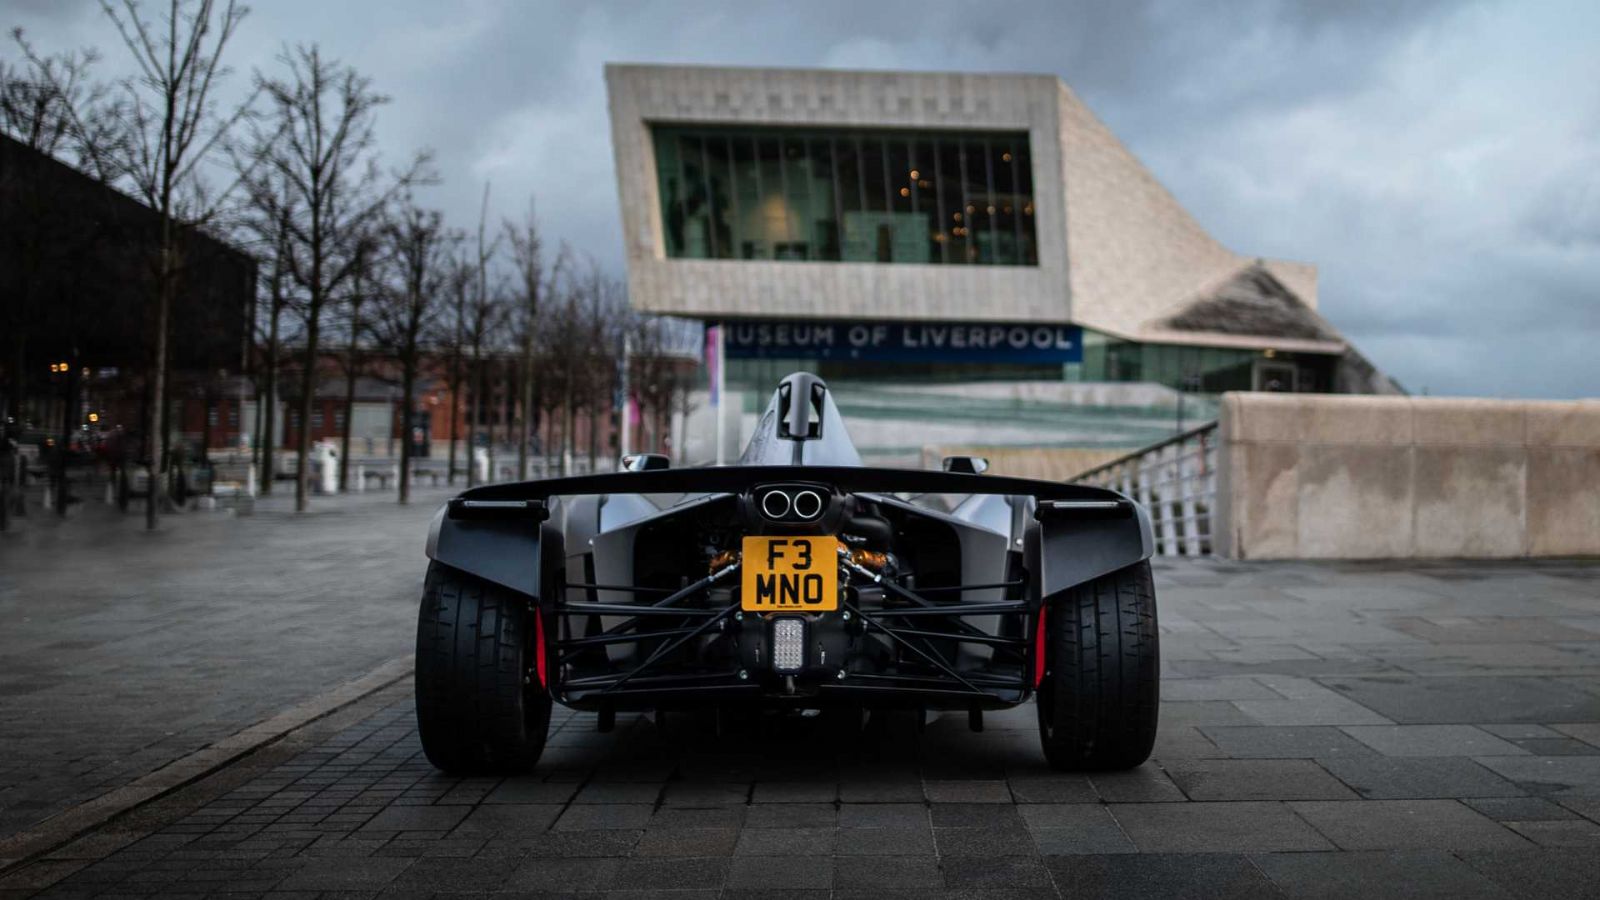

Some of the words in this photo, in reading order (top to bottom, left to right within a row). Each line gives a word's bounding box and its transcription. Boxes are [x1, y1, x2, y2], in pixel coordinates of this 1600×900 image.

[848, 324, 887, 347] OF
[902, 325, 1073, 350] LIVERPOOL
[768, 539, 812, 570] F3
[756, 573, 823, 604] MNO
